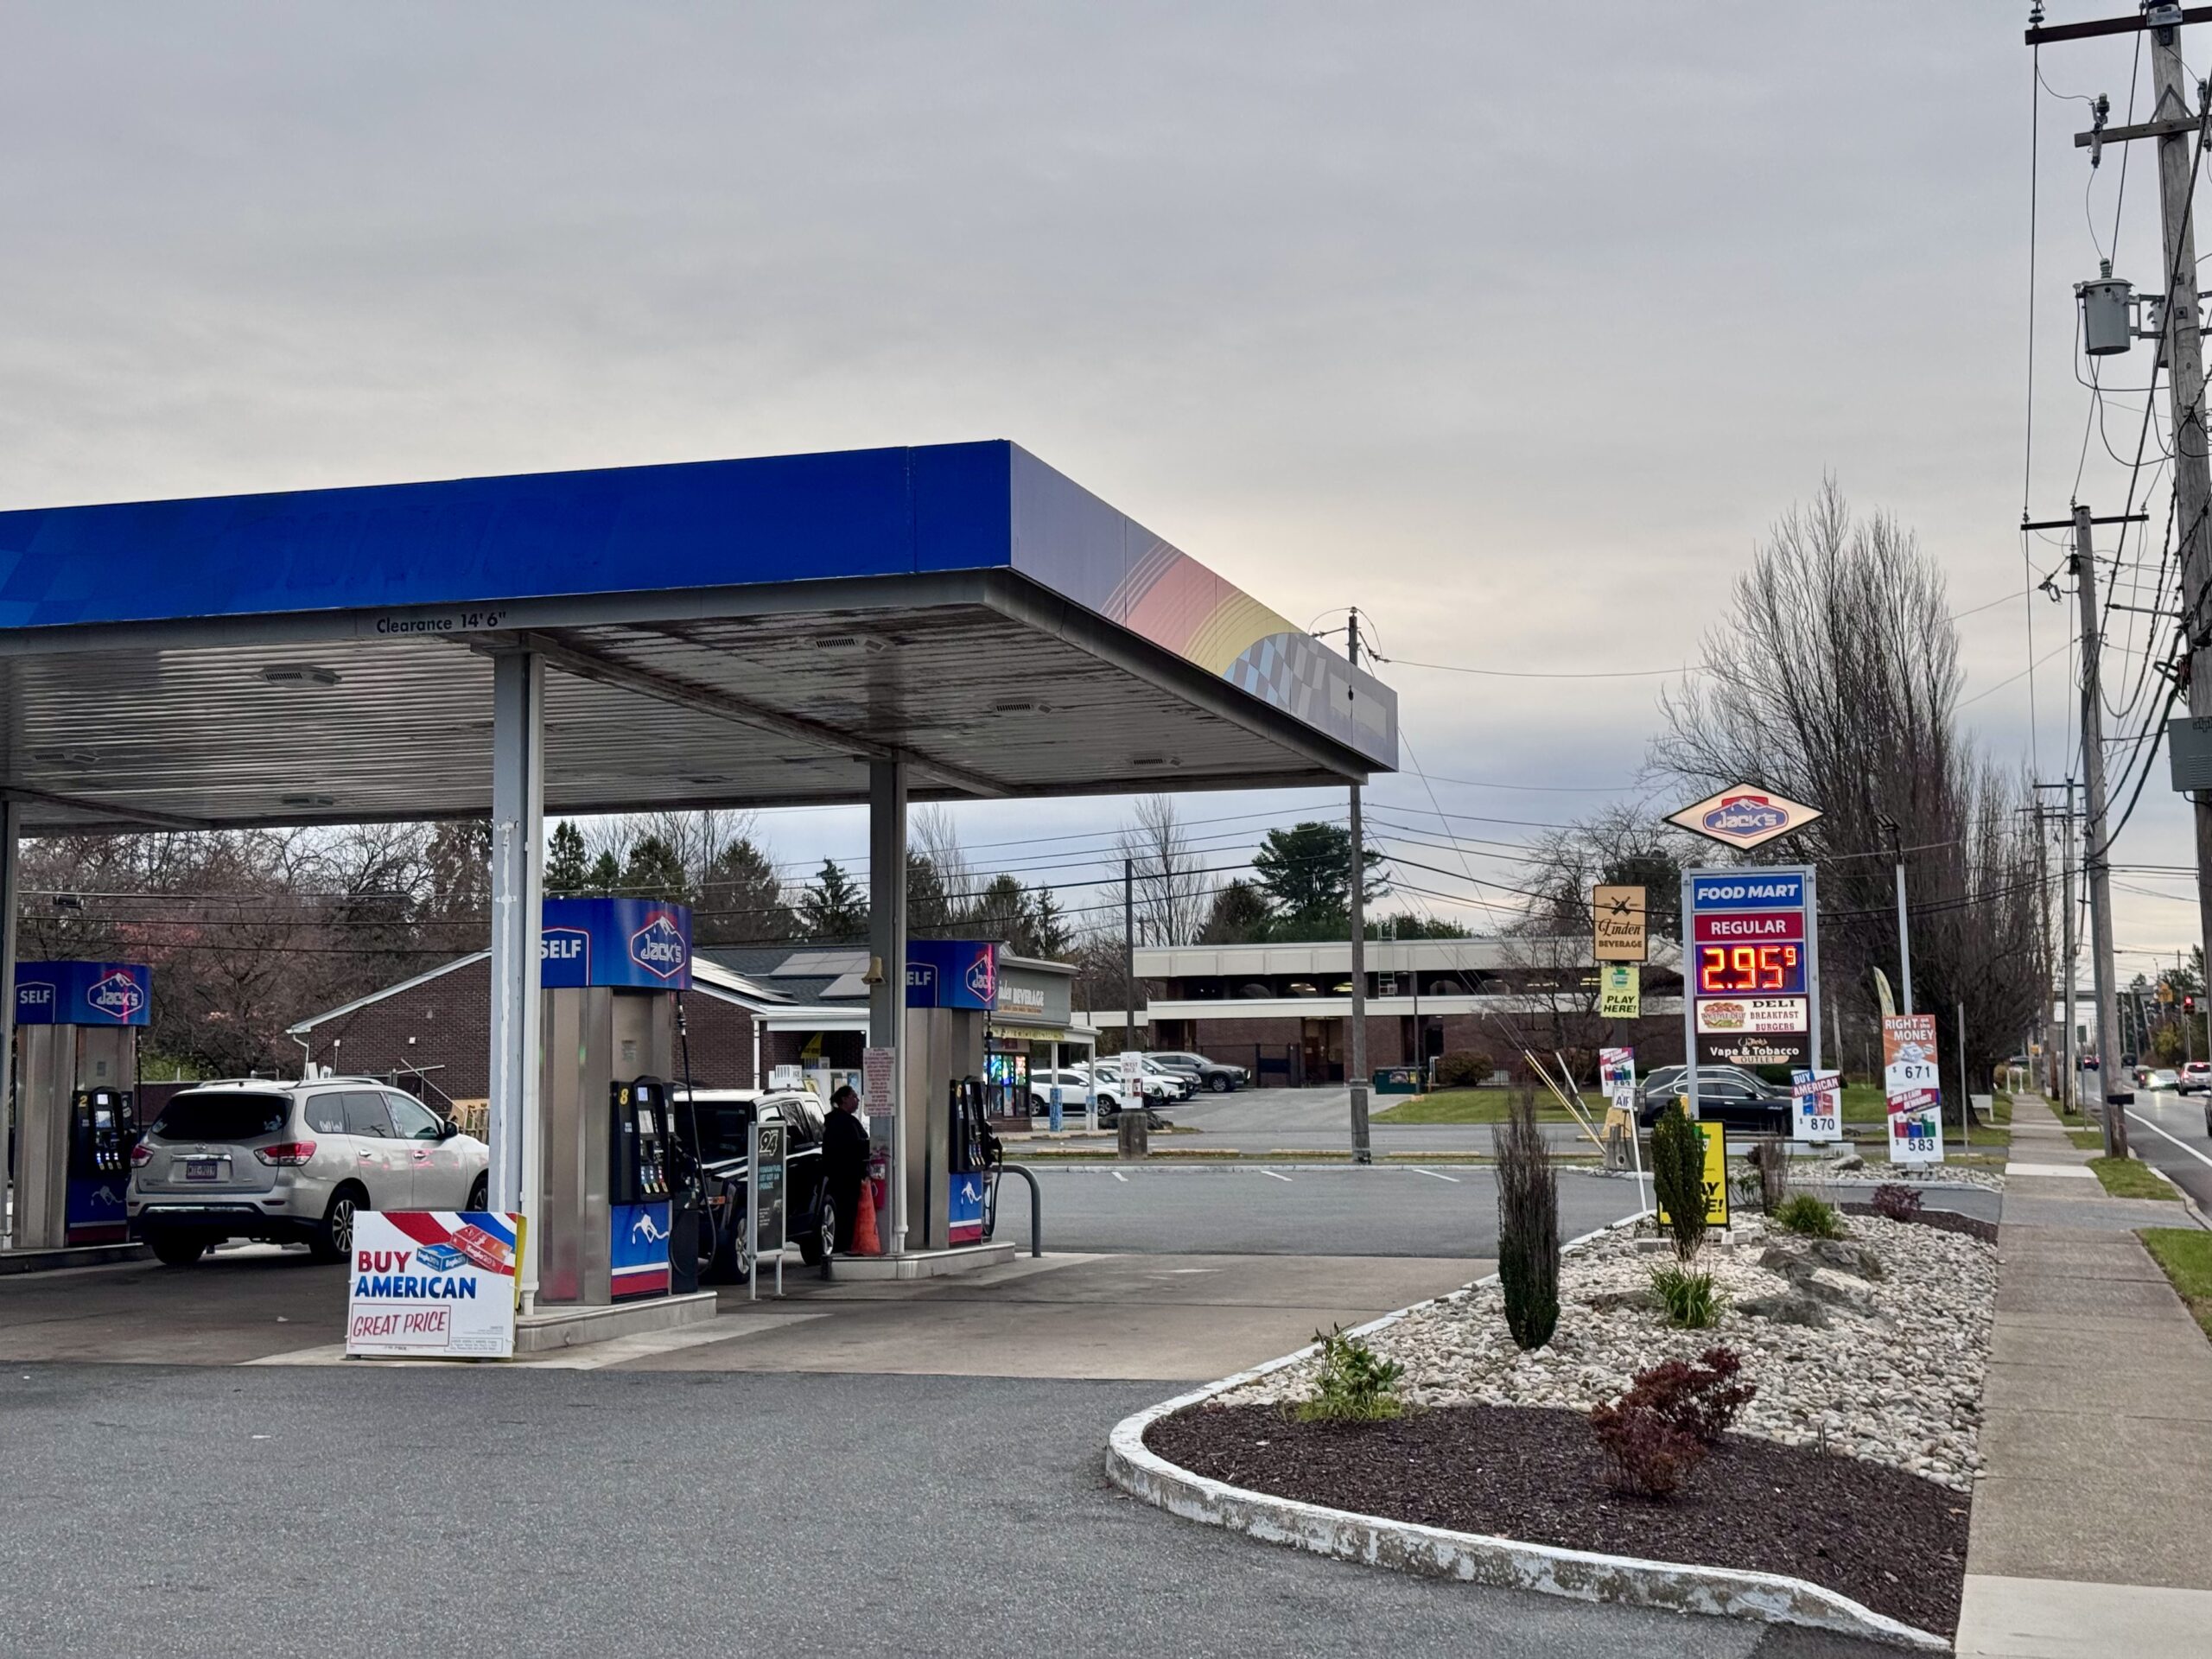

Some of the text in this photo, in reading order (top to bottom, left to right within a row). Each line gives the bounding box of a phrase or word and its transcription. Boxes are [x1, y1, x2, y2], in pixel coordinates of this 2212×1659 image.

[377, 618, 453, 633] Clearance
[1714, 810, 1777, 829] Jack's
[1697, 884, 1799, 900] FOOD MART
[1598, 918, 1641, 937] Linden
[1711, 919, 1787, 936] REGULAR
[640, 933, 682, 963] Jack's
[906, 971, 931, 986] ELF
[20, 990, 50, 1004] SELF
[1013, 988, 1045, 1007] BEVERAGE
[1606, 995, 1635, 1004] PLAY
[1752, 1000, 1796, 1008] DELI
[1603, 1005, 1637, 1014] HERE!
[1750, 1011, 1799, 1020] BREAKFAST
[1885, 1018, 1917, 1029] RIGHT
[1893, 1030, 1934, 1040] MONEY
[1710, 1046, 1799, 1058] Vape & Tobacco
[957, 1084, 962, 1098] 6
[1794, 1077, 1839, 1096] AMERICAN
[79, 1096, 87, 1108] 2
[620, 1088, 629, 1105] 8
[759, 1130, 779, 1156] 94
[358, 1251, 412, 1273] BUY
[355, 1275, 476, 1299] AMERICAN
[353, 1312, 448, 1338] GREAT PRICE
